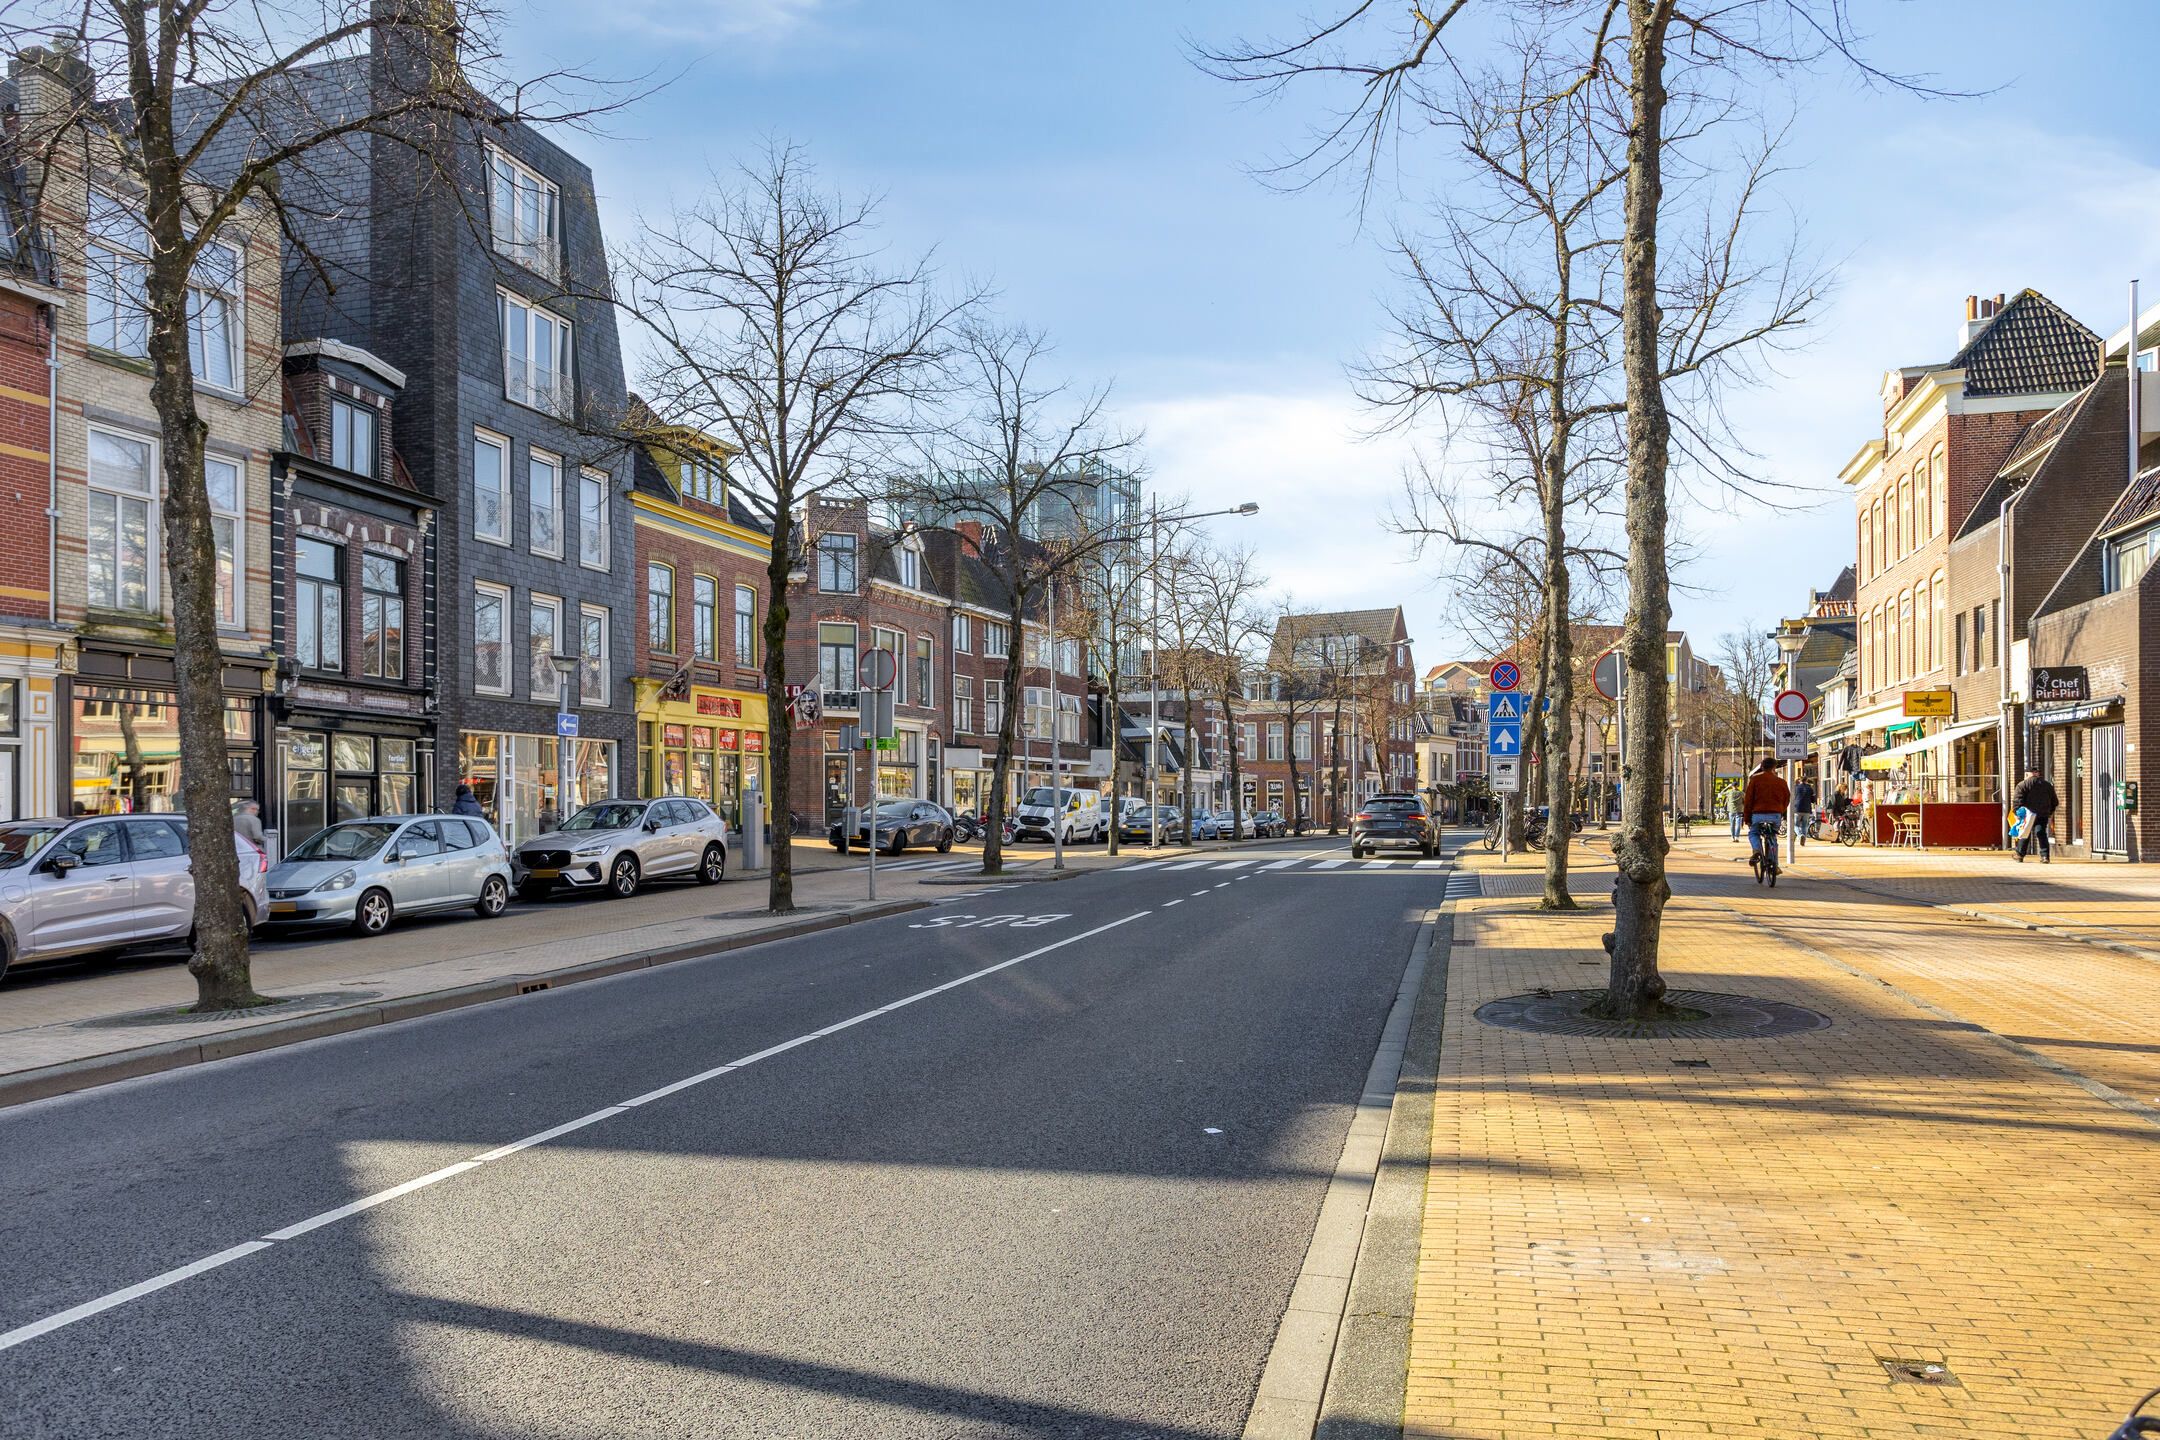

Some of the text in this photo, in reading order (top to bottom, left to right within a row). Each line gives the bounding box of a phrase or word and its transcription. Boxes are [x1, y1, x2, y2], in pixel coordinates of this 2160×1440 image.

[2051, 678, 2079, 688] Chef
[2036, 688, 2080, 699] Piri-Piri
[908, 913, 1074, 928] BUS
